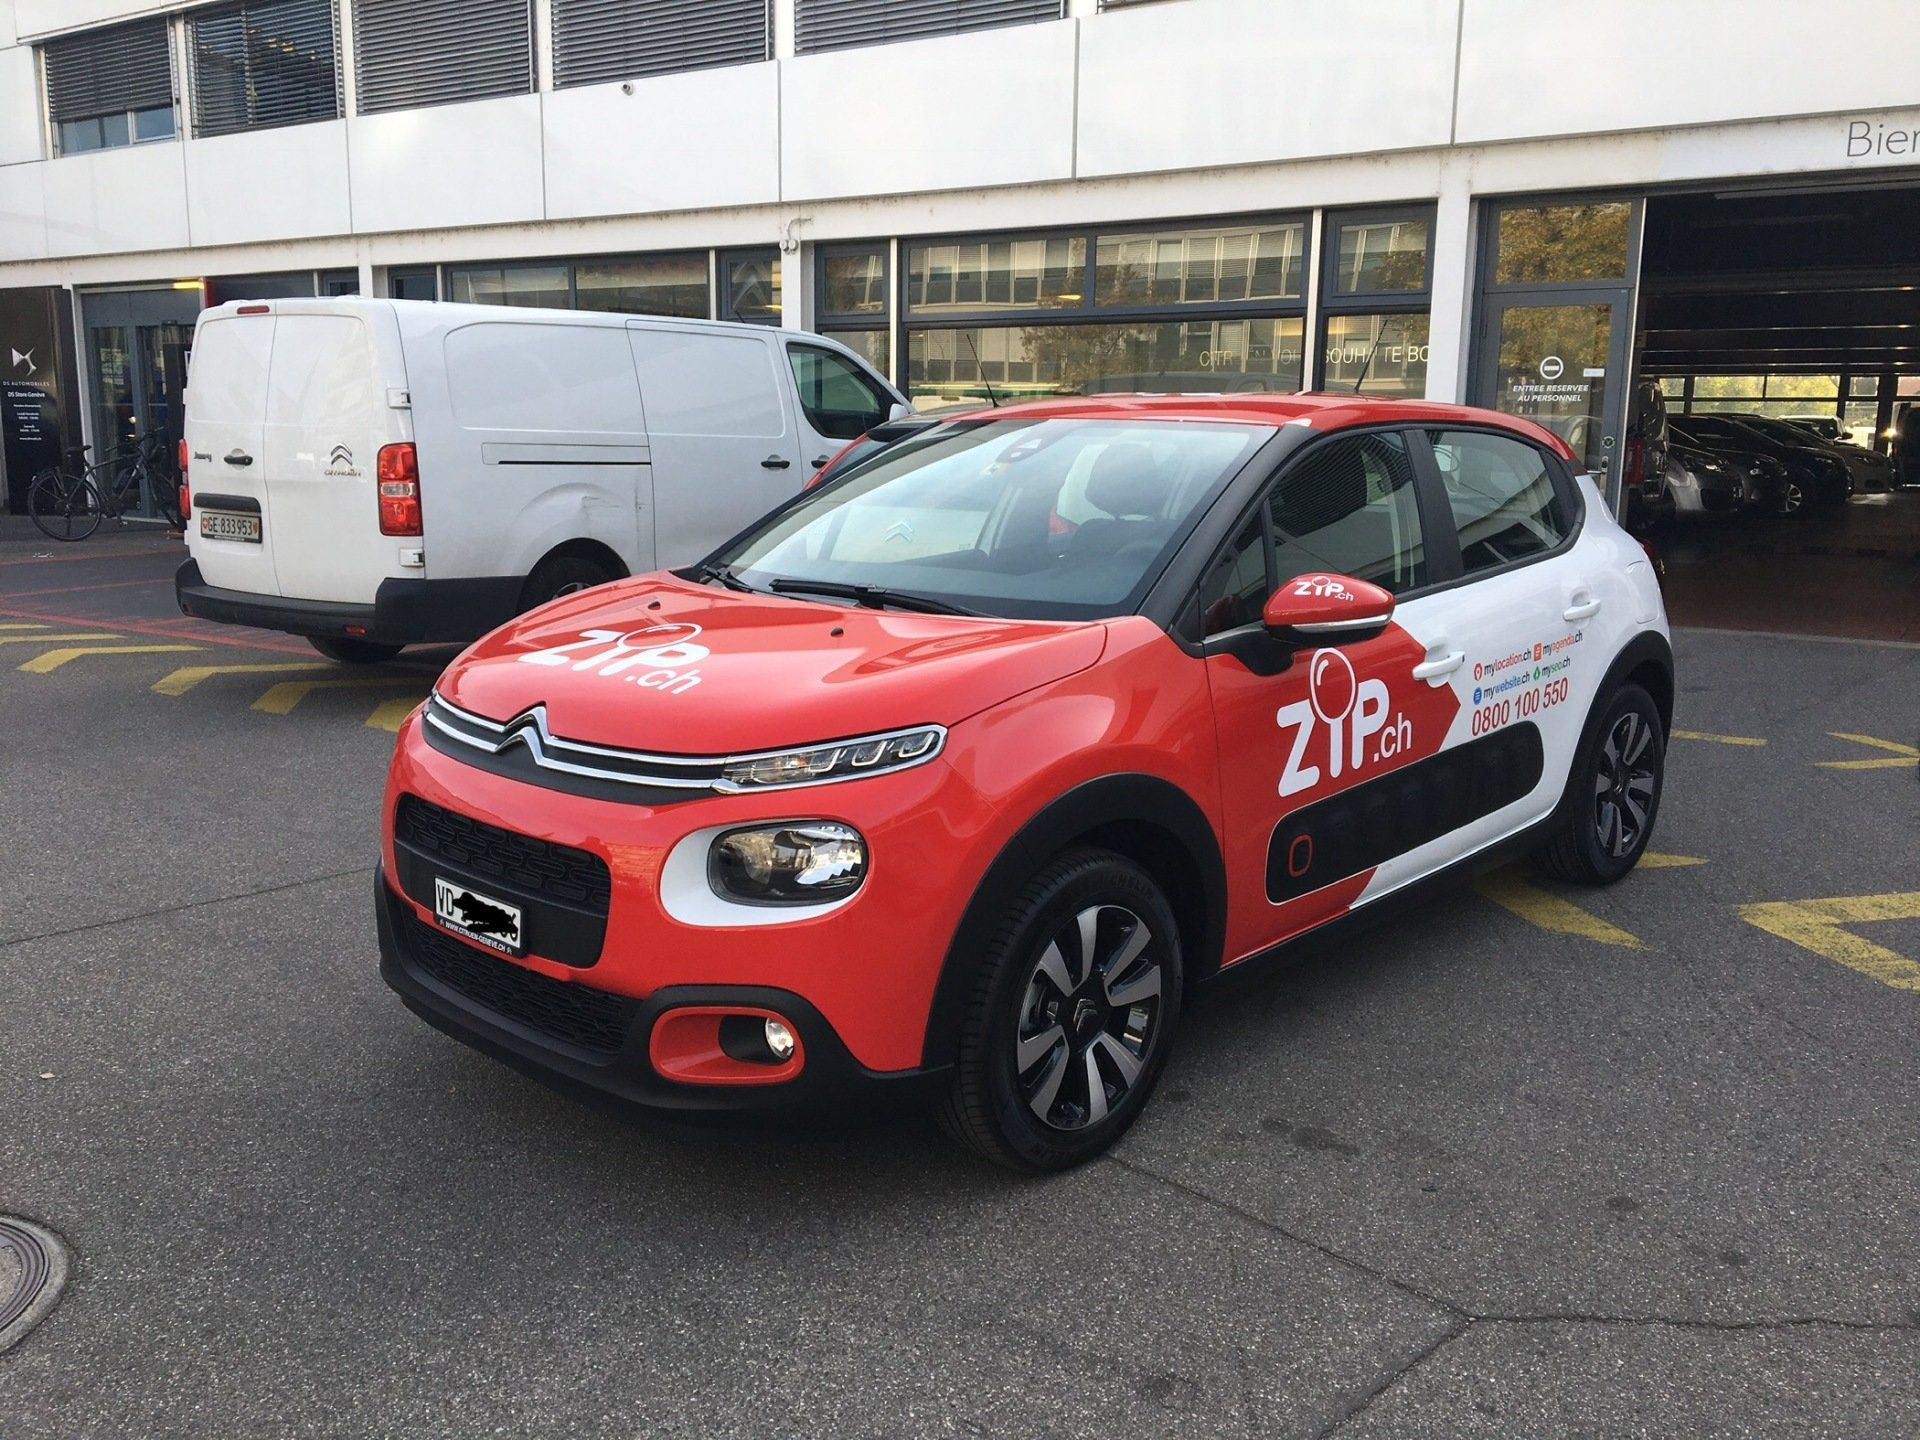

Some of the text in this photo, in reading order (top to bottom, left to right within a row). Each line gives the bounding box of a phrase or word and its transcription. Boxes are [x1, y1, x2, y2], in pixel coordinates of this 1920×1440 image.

[1512, 384, 1589, 392] ENTREE RESERVEE
[1517, 394, 1582, 402] AU PERSONNEL
[1484, 630, 1583, 677] mylocation.ch myagenda.ch
[1483, 656, 1571, 699] mywebsite.ch myseo.ch
[1472, 677, 1568, 736] 0800 100 550
[437, 884, 454, 917] VD
